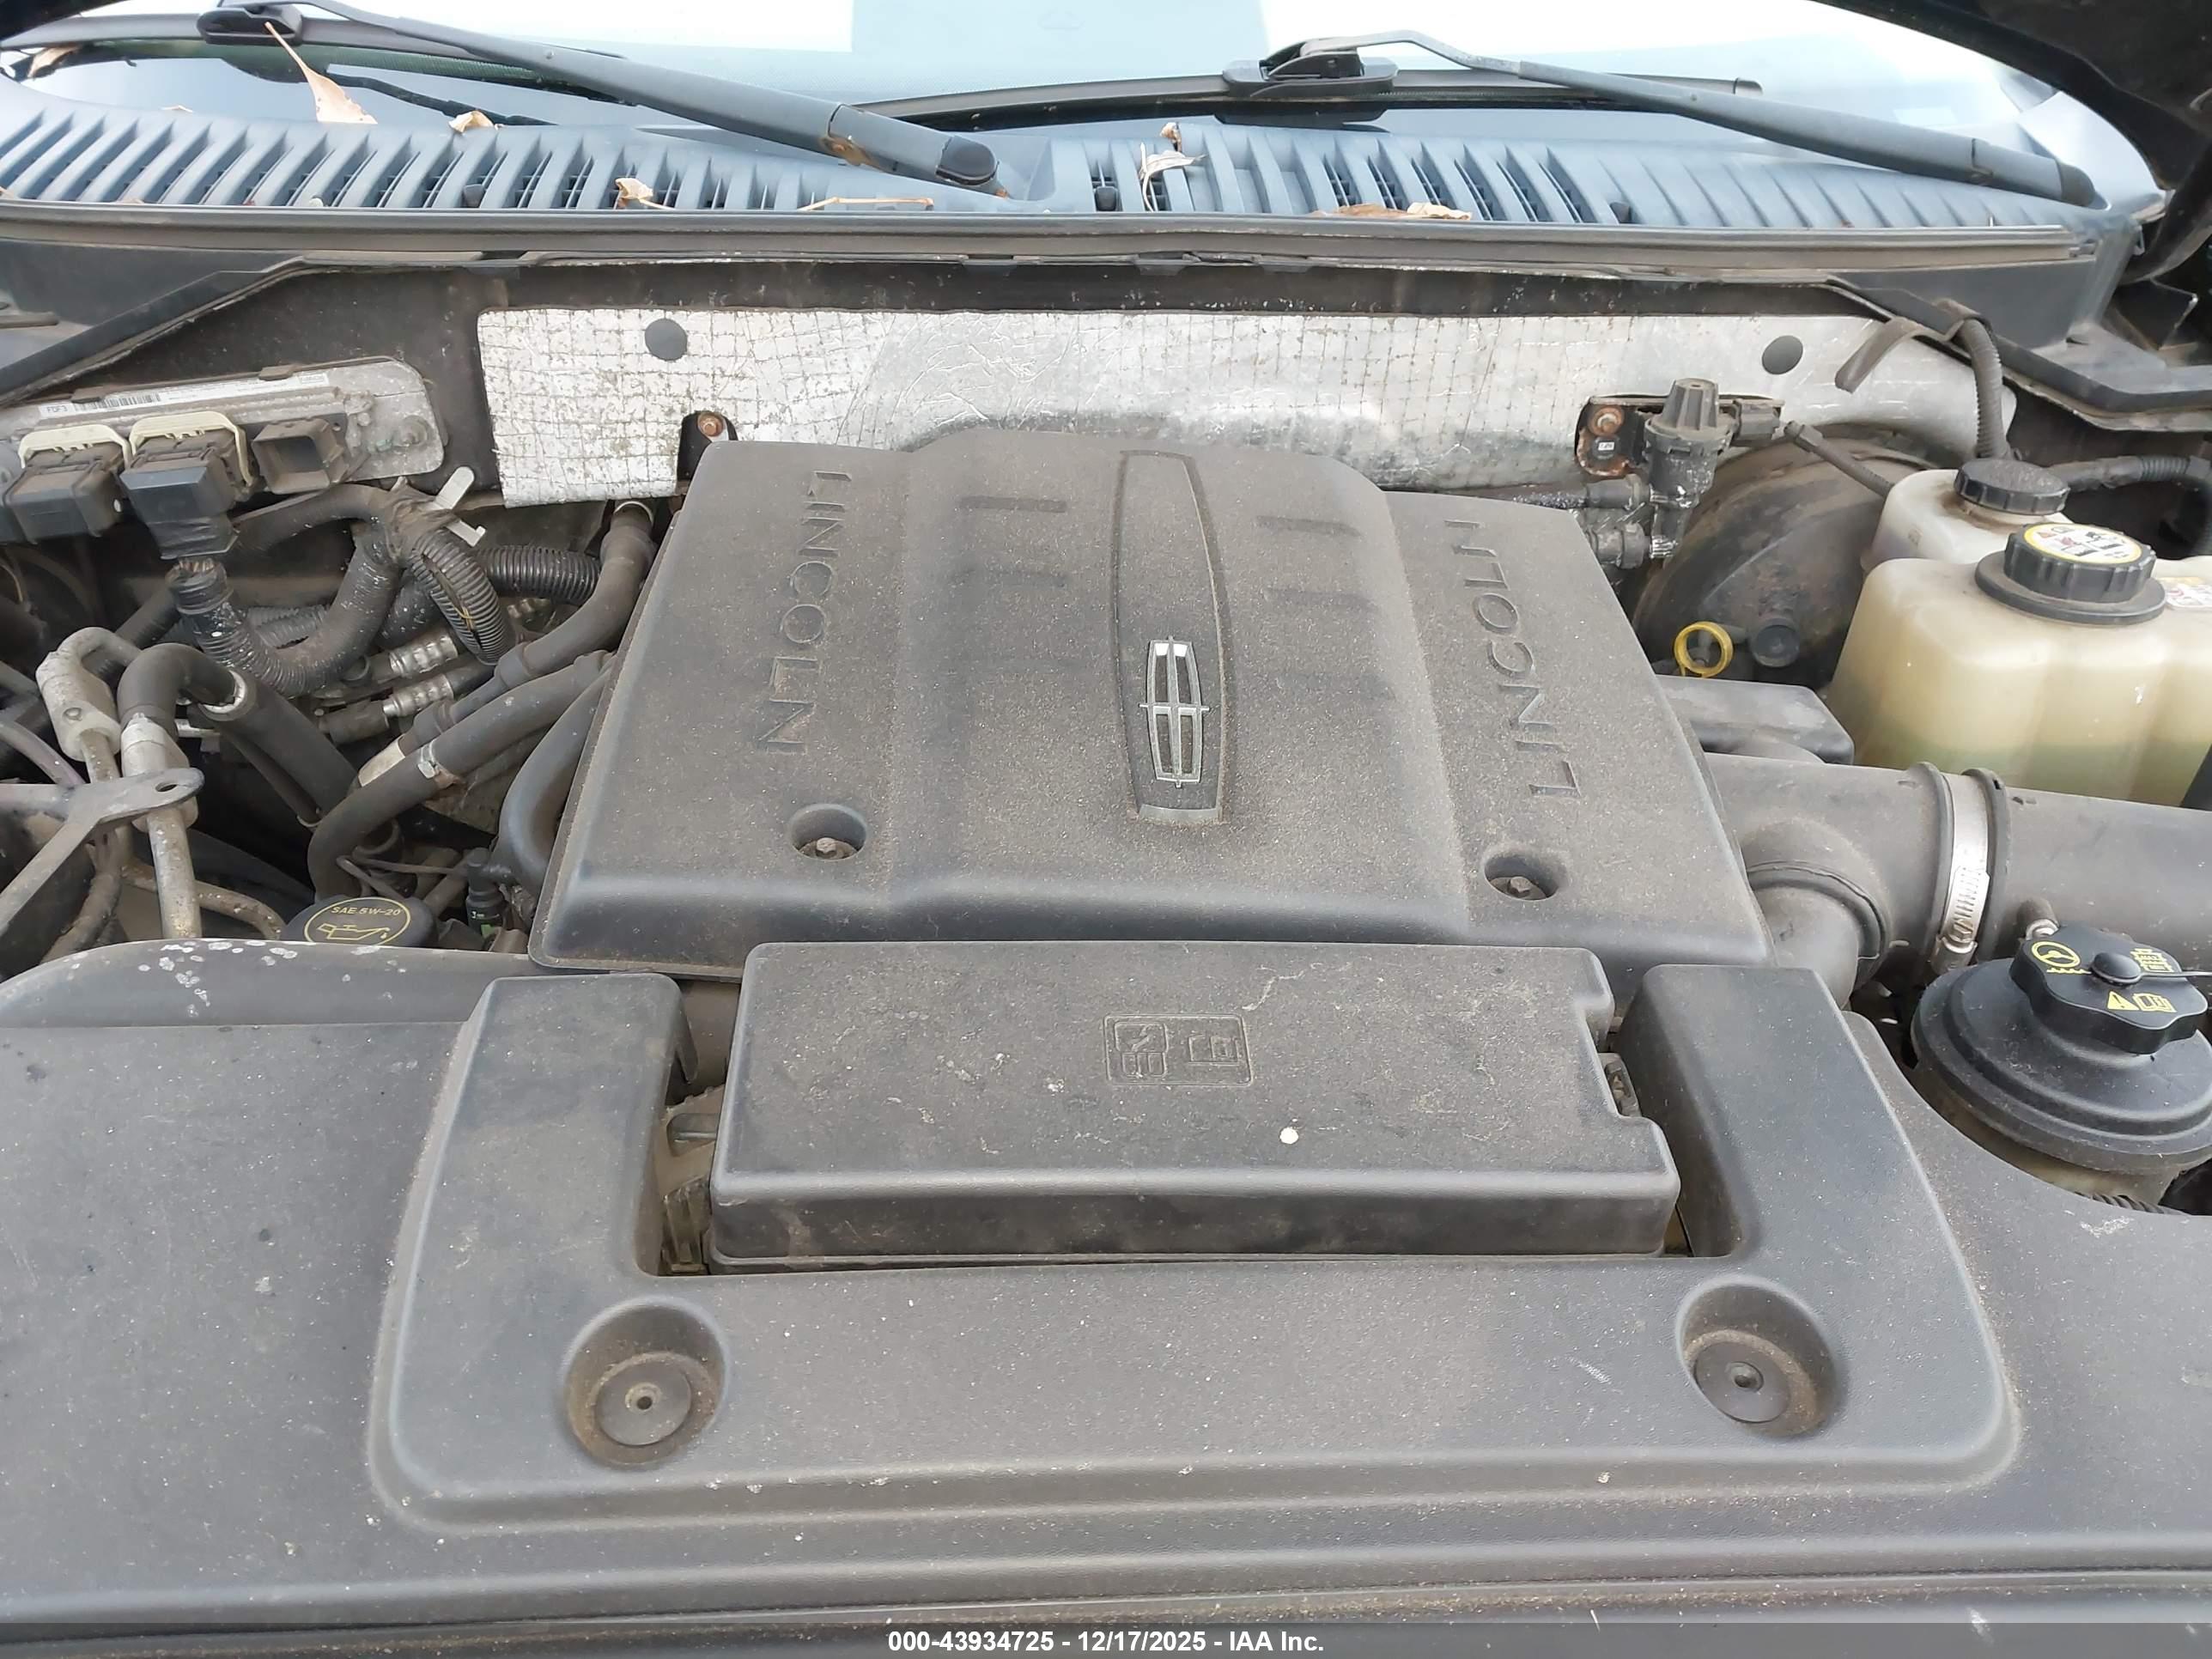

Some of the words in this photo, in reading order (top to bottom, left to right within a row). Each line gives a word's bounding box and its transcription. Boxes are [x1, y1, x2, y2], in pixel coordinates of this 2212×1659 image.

[757, 470, 852, 753] LINCOLN
[1444, 520, 1581, 797] LINCOLN
[331, 906, 358, 915] SAE
[359, 907, 402, 916] 5W-20
